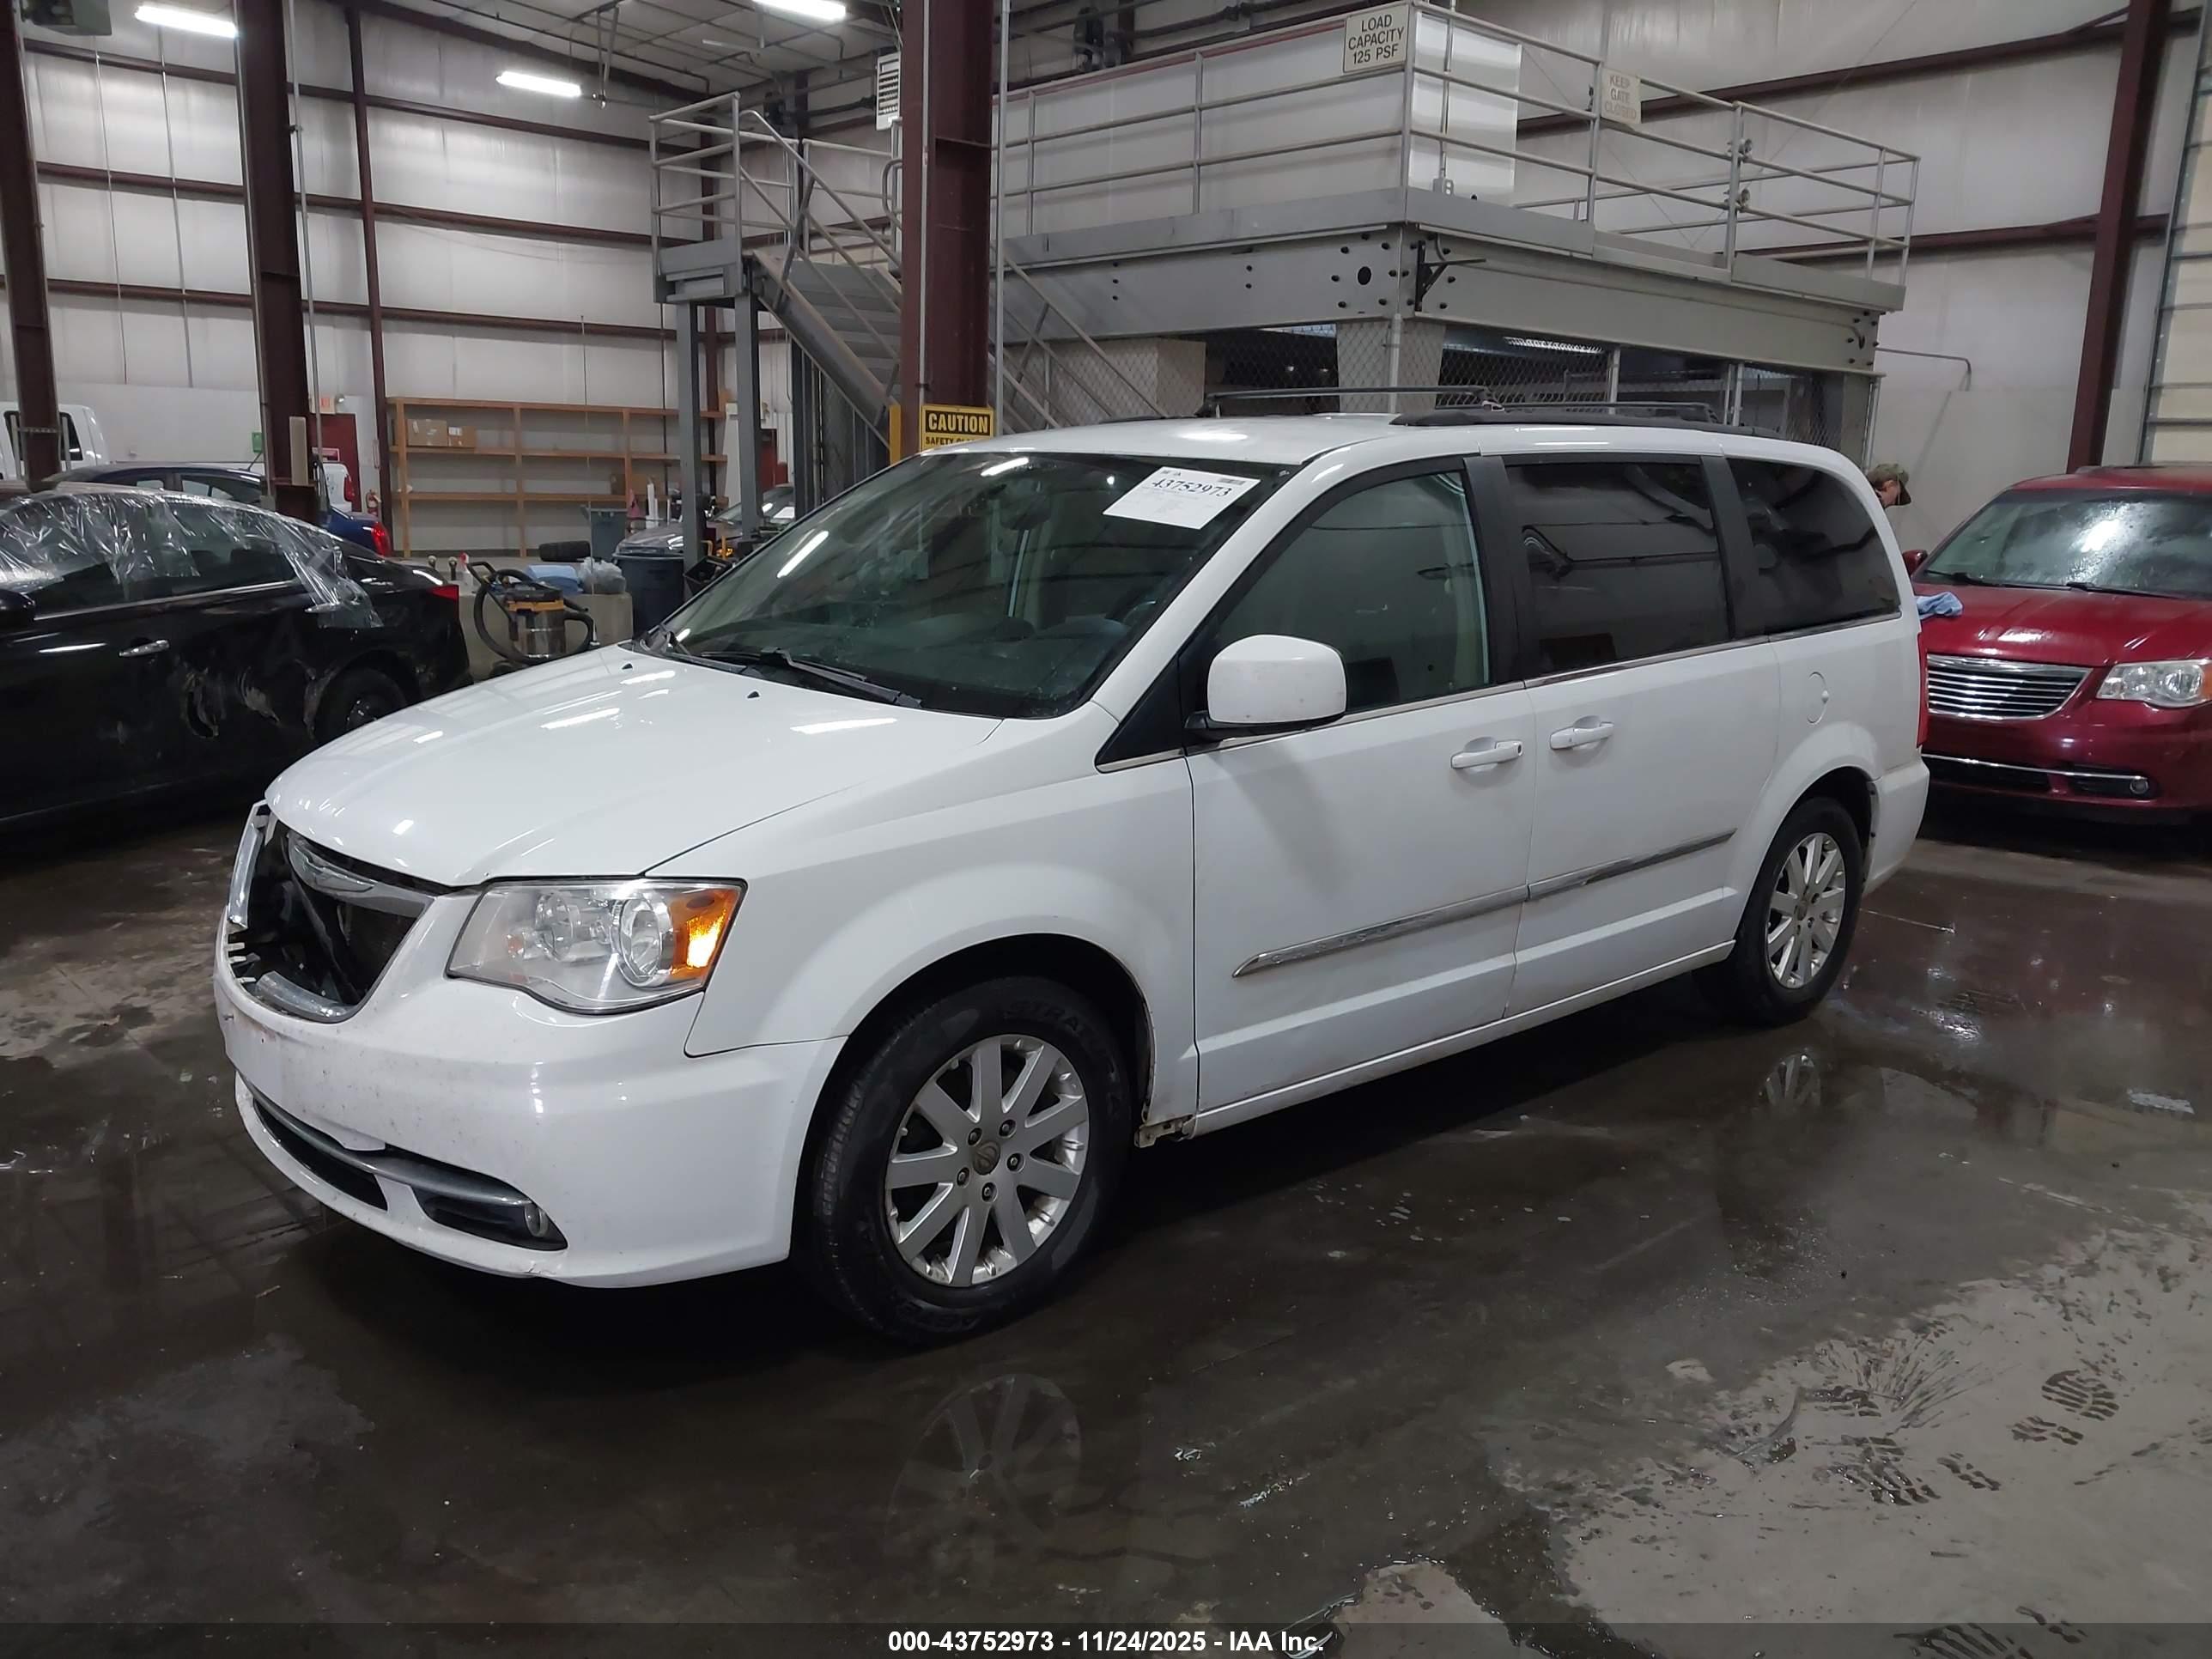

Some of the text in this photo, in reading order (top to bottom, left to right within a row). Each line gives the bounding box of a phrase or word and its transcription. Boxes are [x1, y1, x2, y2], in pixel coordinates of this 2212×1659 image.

[1361, 14, 1393, 33] LOAD
[1348, 26, 1405, 50] CAPACITY
[1353, 44, 1399, 64] 125 PSF
[928, 412, 988, 434] CAUTION
[925, 436, 954, 446] SAFETY
[1152, 477, 1232, 498] 43752973
